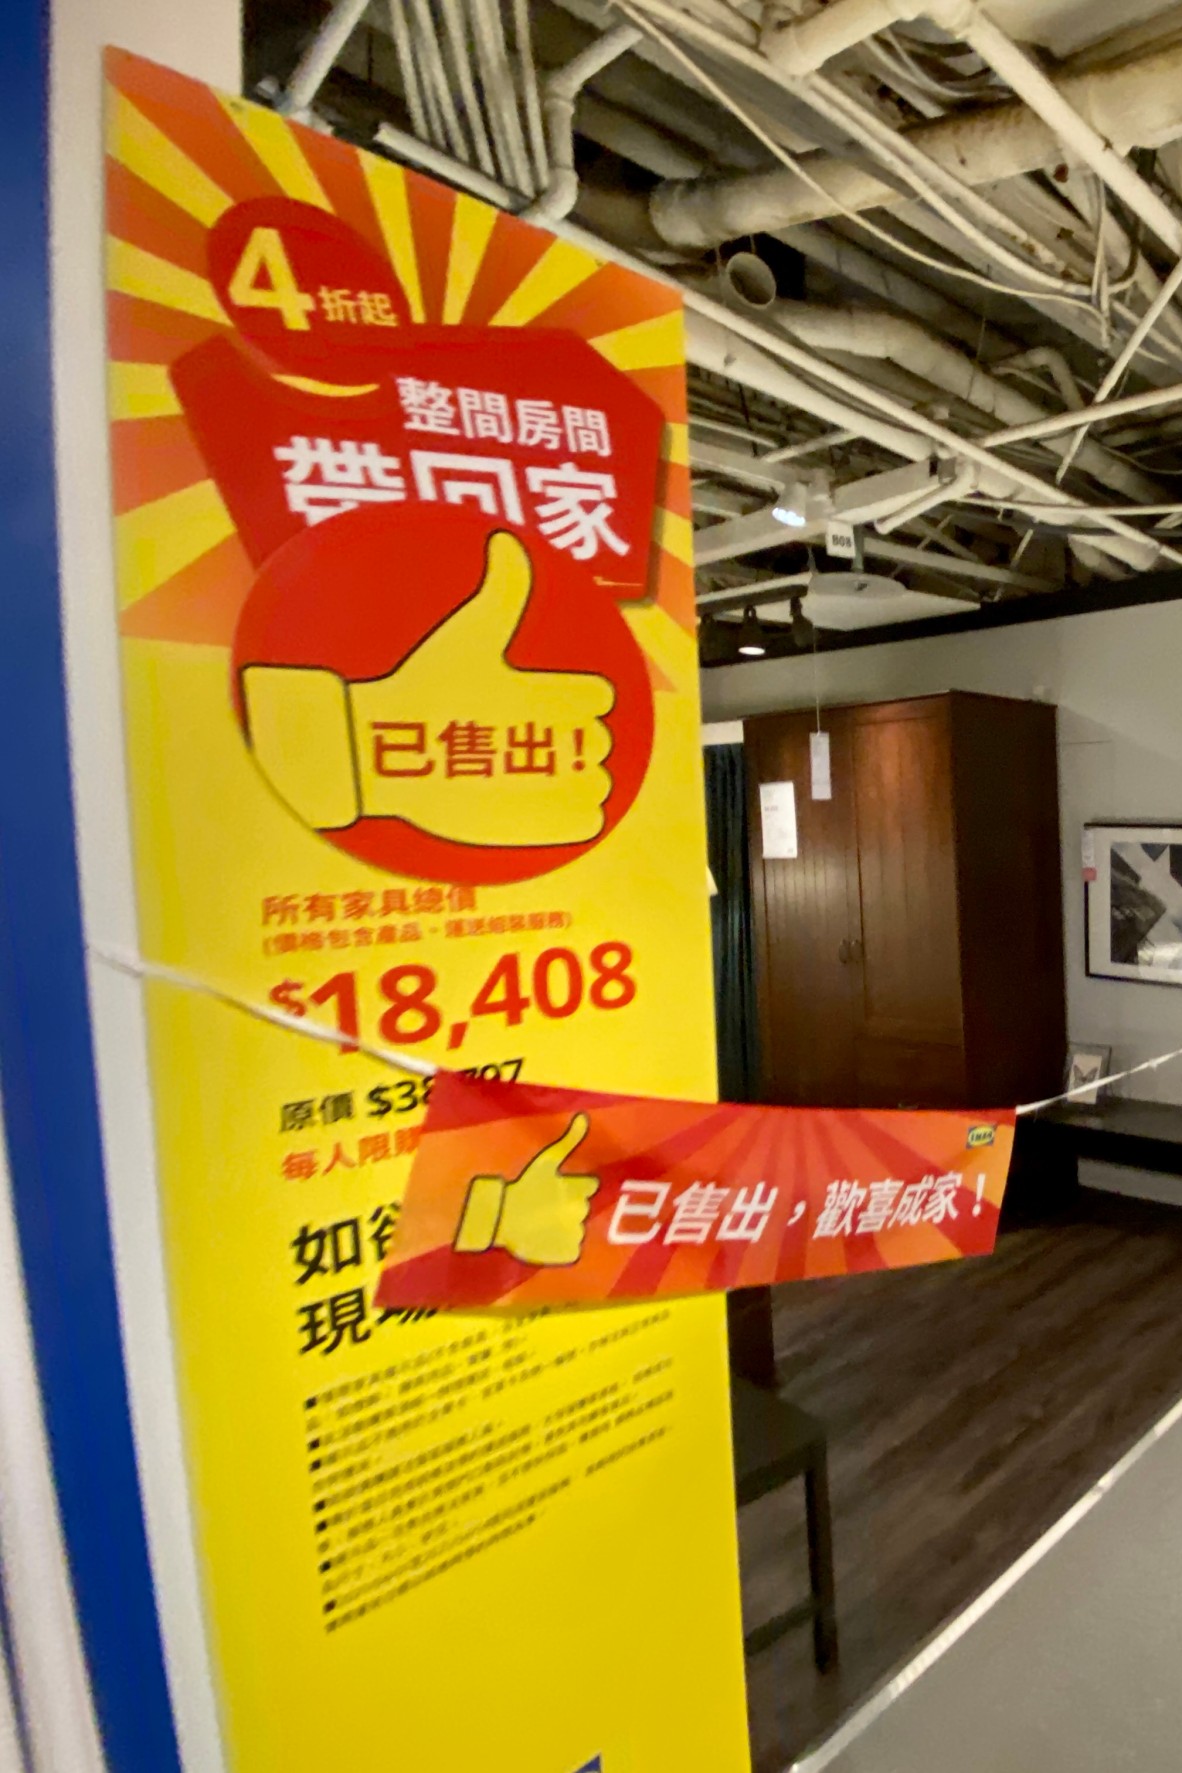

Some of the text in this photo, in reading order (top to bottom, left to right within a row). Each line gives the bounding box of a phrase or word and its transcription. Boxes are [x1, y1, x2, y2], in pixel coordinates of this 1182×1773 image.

[396, 375, 613, 458] 整間房間
[268, 940, 638, 1056] $18,408
[280, 1092, 353, 1133] 原價
